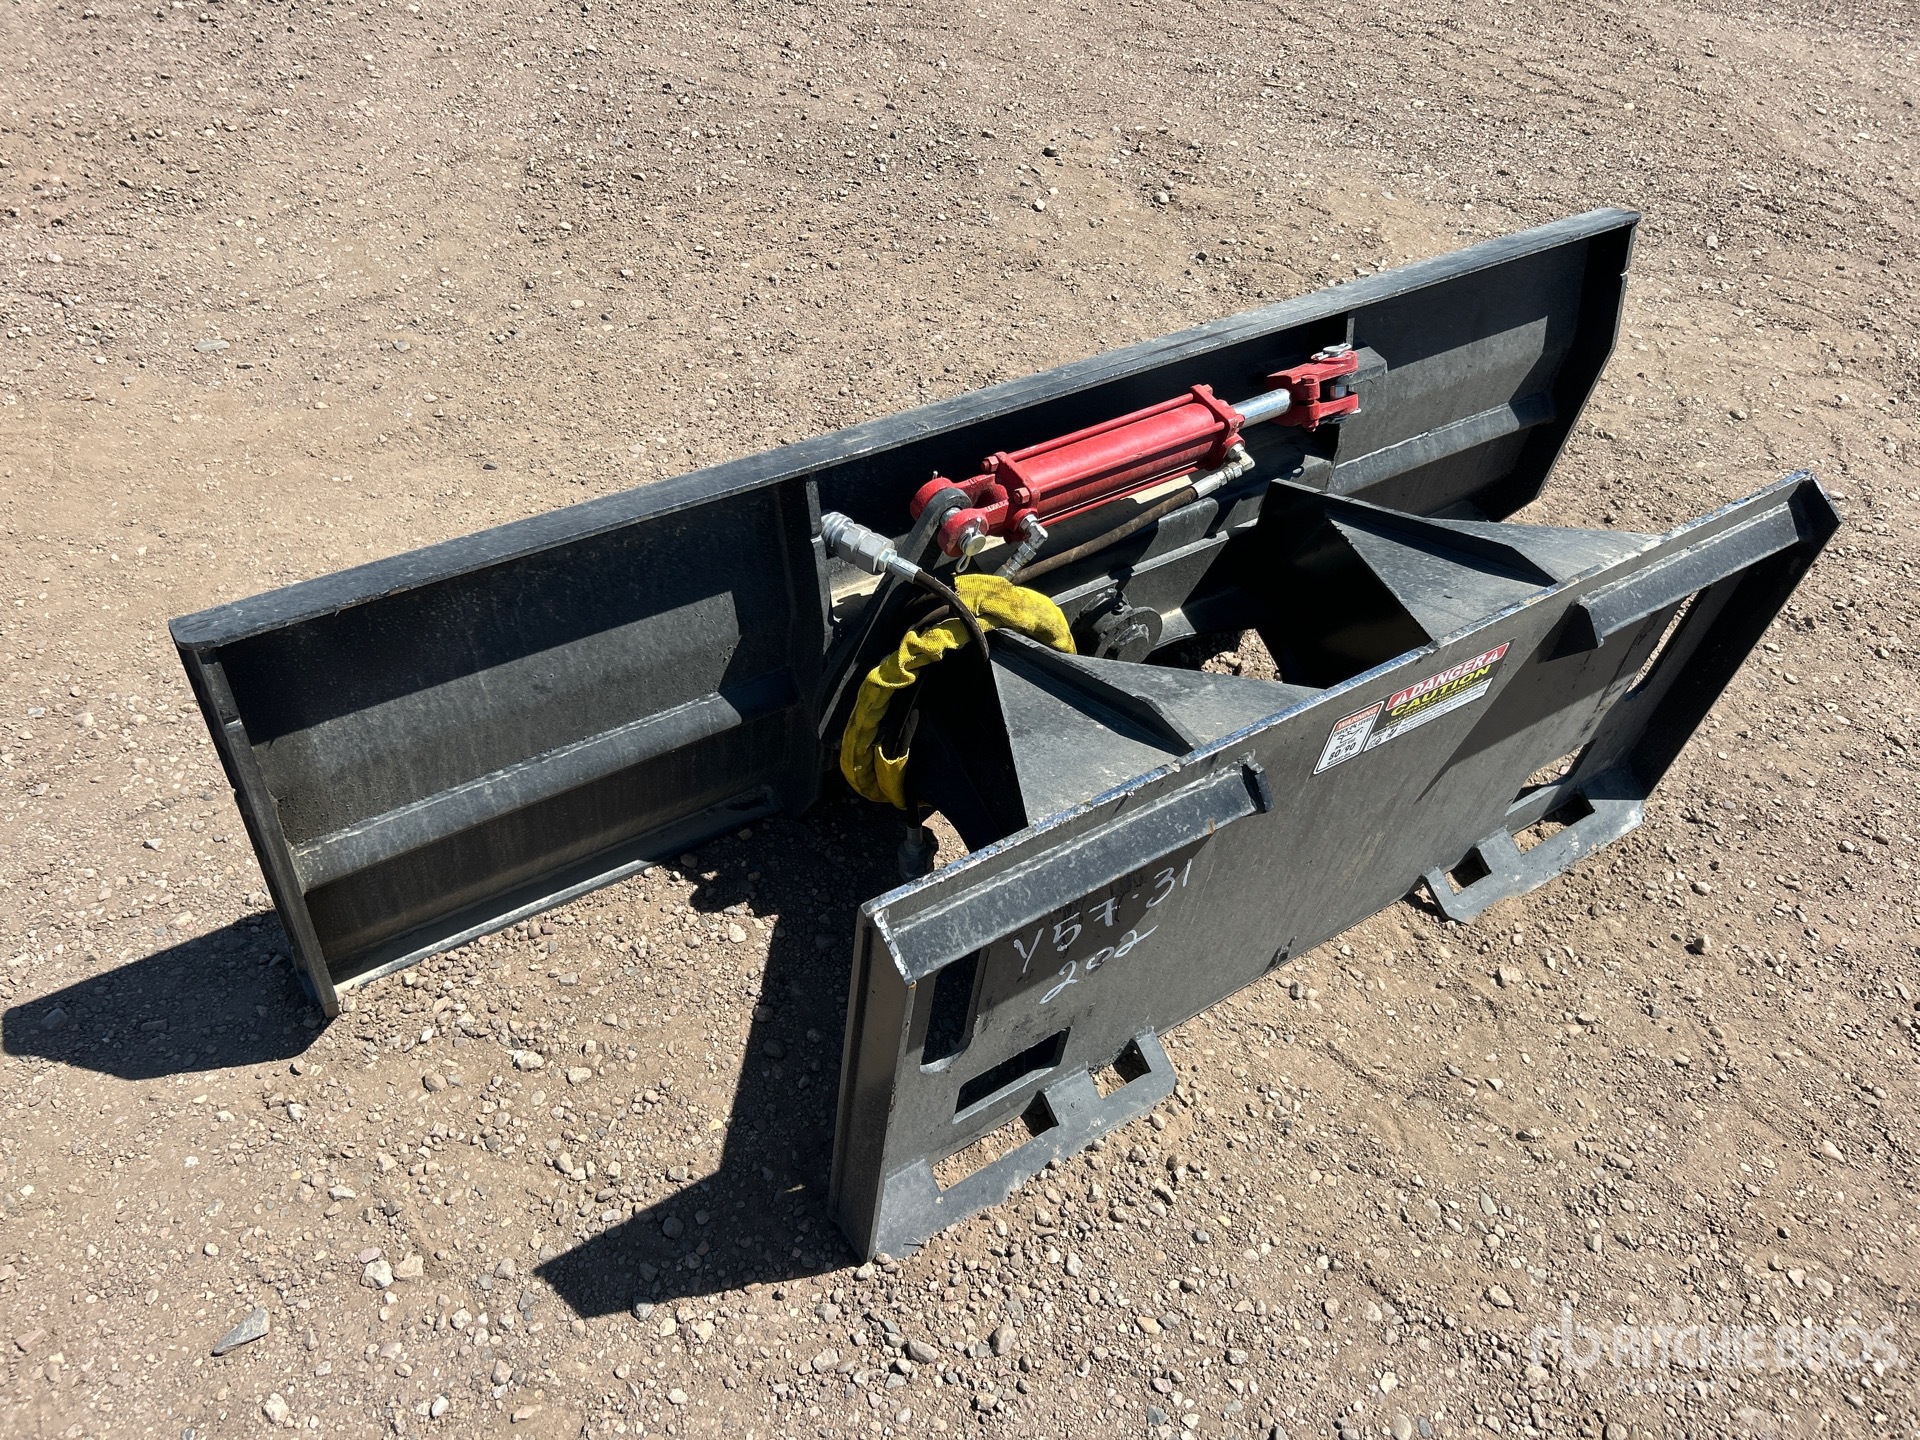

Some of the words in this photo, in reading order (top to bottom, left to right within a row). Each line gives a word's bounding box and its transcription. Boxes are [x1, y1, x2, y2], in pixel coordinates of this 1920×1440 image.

[1391, 664, 1491, 716] CAUTION
[1411, 656, 1486, 697] DANGER
[1335, 705, 1380, 732] WARNING
[1328, 742, 1356, 760] 80/90
[1039, 924, 1159, 1005] 202
